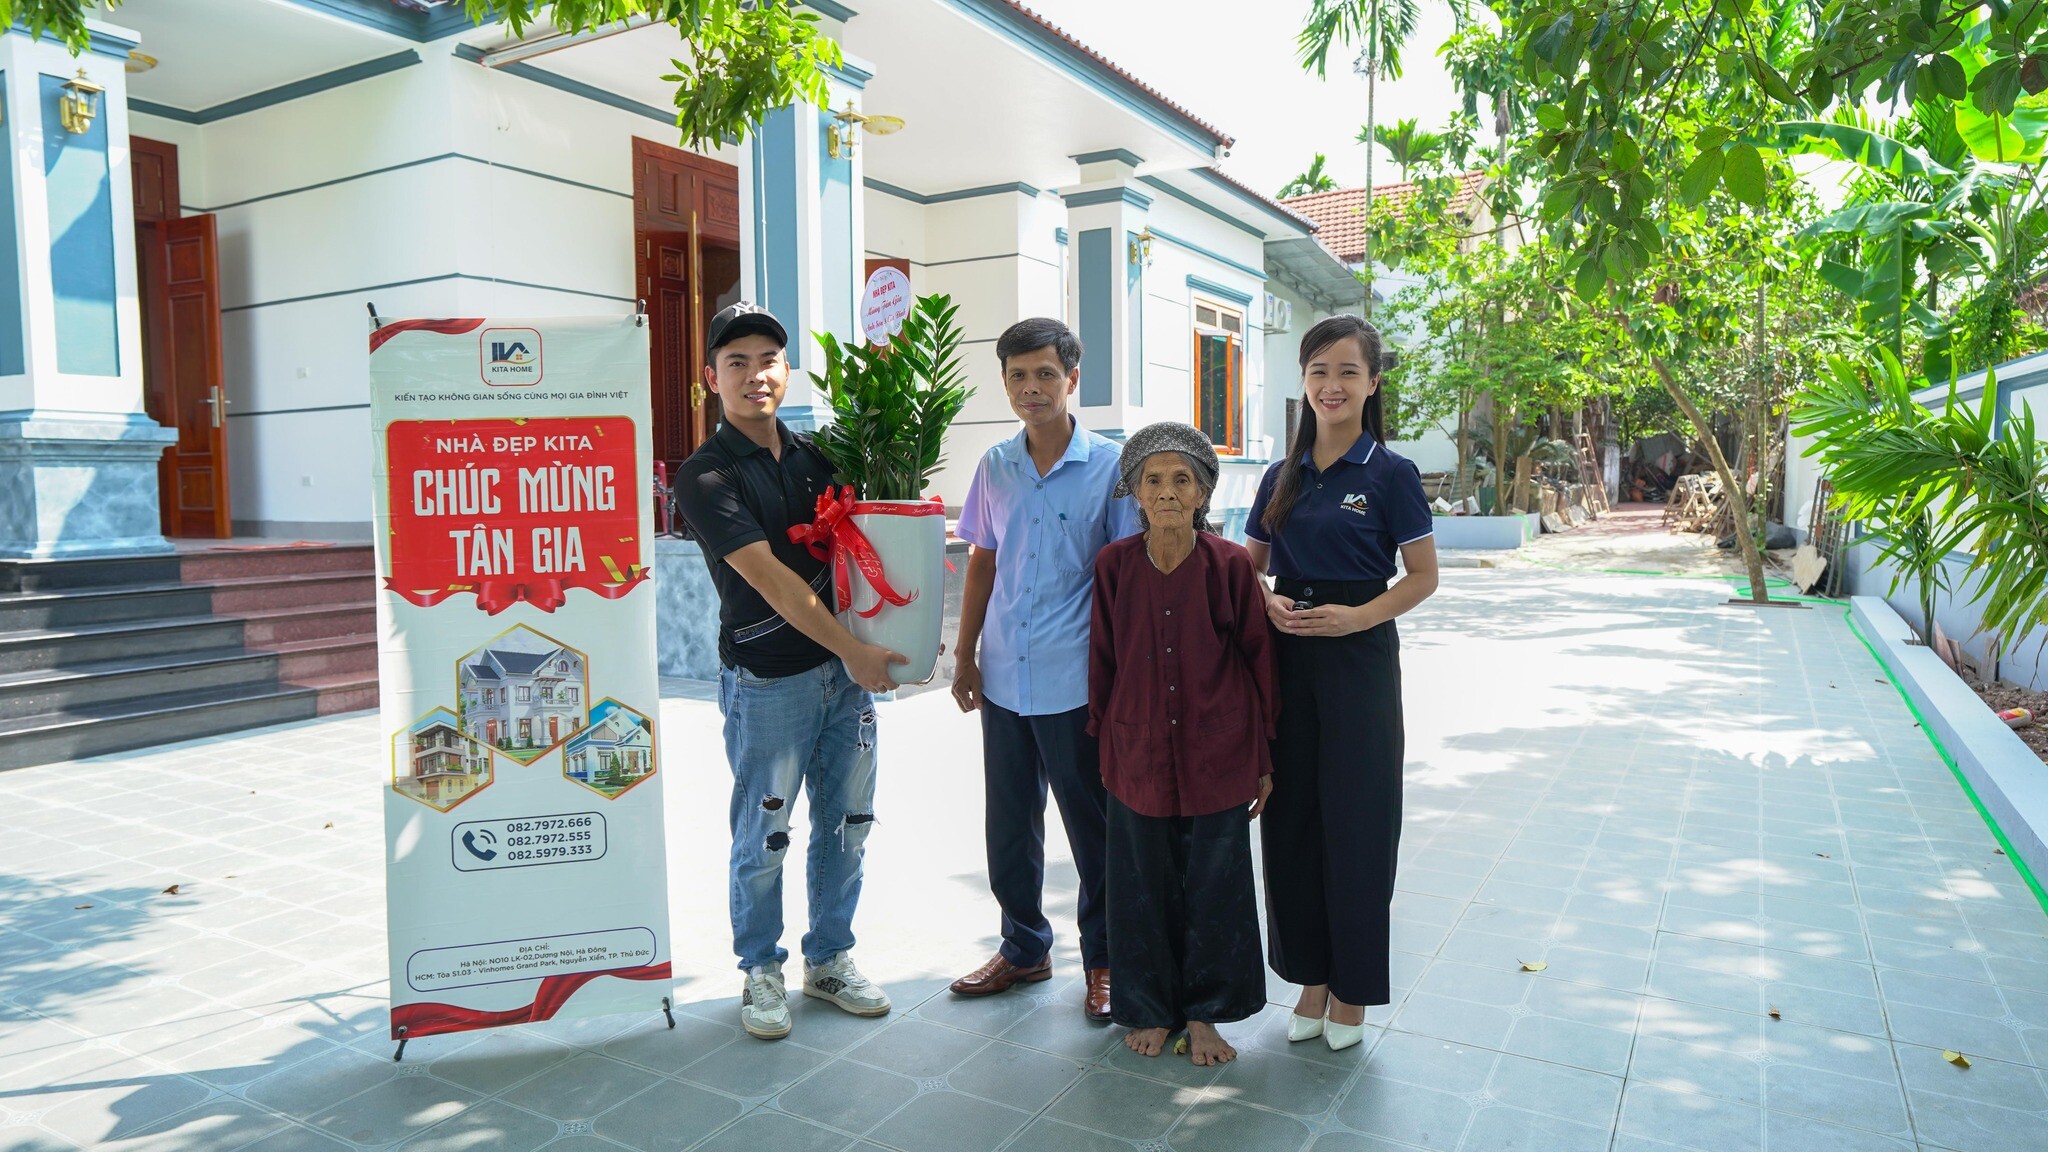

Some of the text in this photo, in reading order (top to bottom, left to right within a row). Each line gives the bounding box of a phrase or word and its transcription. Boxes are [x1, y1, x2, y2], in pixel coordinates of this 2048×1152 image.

[395, 392, 415, 401] KIẾN
[419, 394, 436, 402] TẠO
[439, 393, 470, 401] KHÔNG
[497, 391, 521, 400] SỐNG
[524, 392, 548, 400] CÙNG
[551, 392, 566, 400] MỌI
[586, 390, 607, 399] ĐÌNH
[610, 390, 628, 399] VIỆT
[436, 433, 593, 456] NHÀ ĐẸP KITA
[413, 461, 616, 516] CHÚC MỪNG
[450, 524, 586, 576] TÂN GIA
[507, 817, 592, 832] 082.7972.666
[508, 831, 591, 846] 082.7972.555
[508, 845, 592, 860] 082.5979.333
[535, 943, 550, 951] CHỈ:
[452, 969, 471, 977] S1.03
[478, 966, 514, 974] Vinhomes
[516, 962, 538, 970] Grand
[560, 956, 587, 965] Nguyễn
